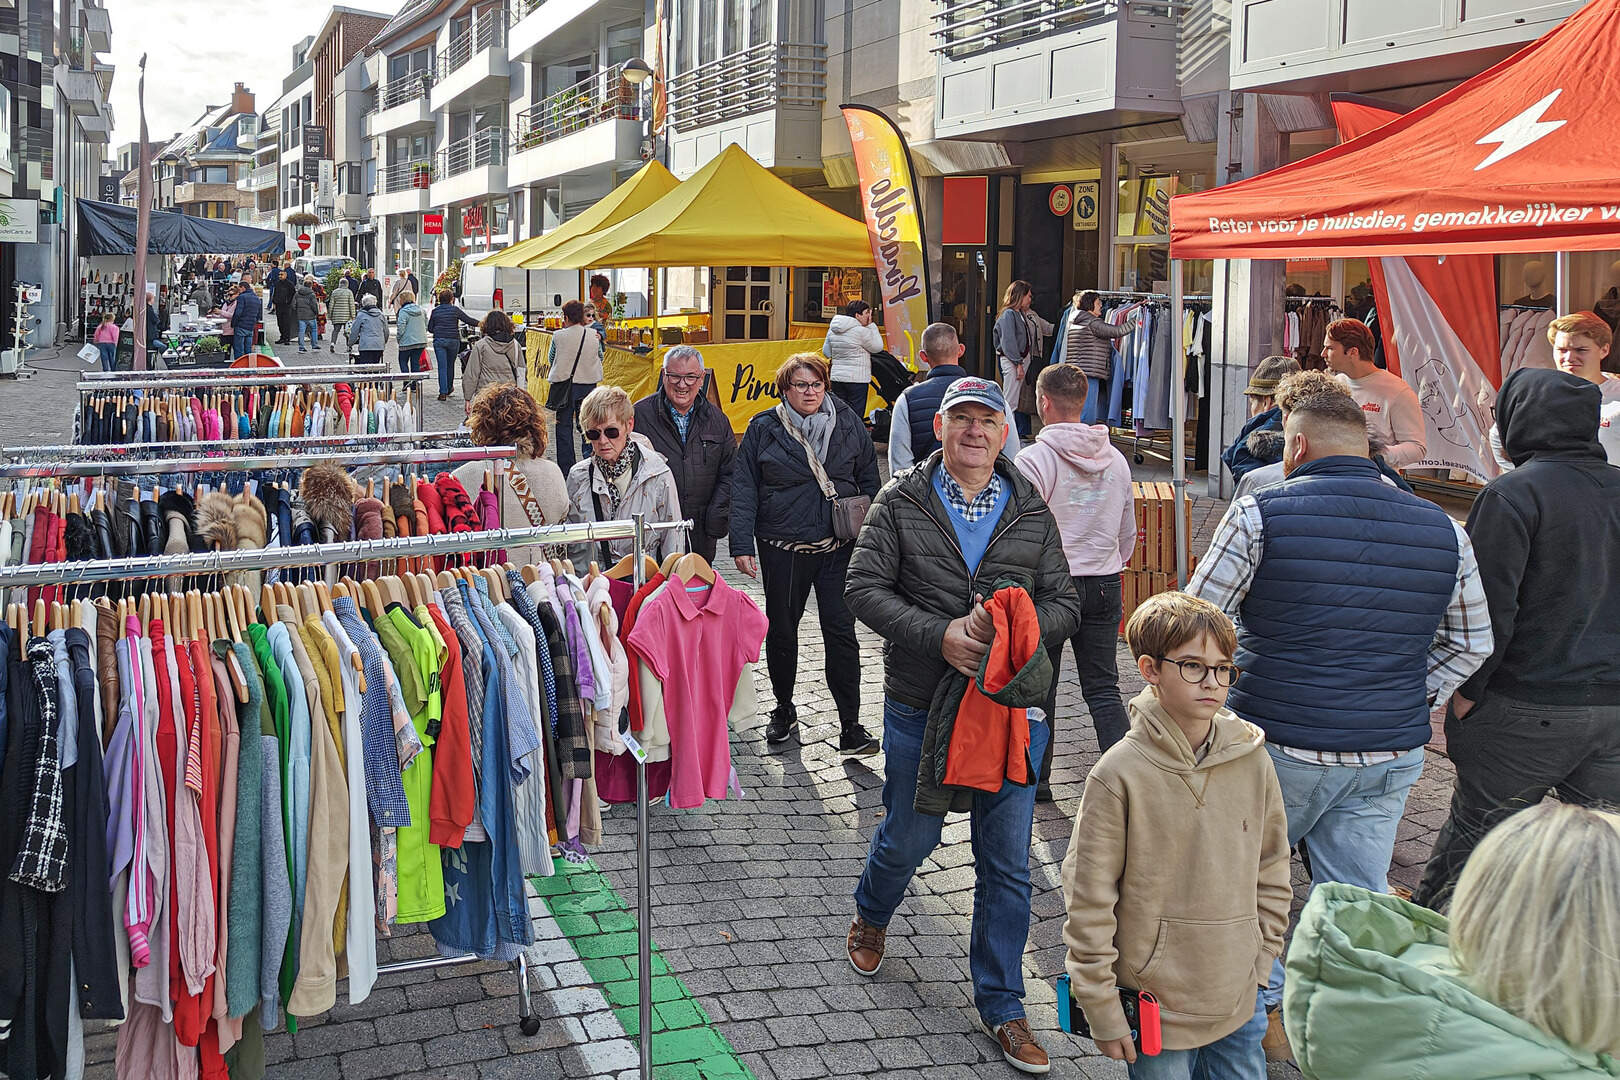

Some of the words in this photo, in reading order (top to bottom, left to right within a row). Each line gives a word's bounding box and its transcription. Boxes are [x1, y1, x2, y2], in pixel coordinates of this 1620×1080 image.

[307, 145, 320, 153] Lee
[1078, 185, 1095, 194] ZONE
[1208, 217, 1253, 233] Beter
[1257, 219, 1298, 233] voor
[1297, 215, 1319, 236] je
[1322, 210, 1406, 231] huisdier,
[1411, 203, 1593, 232] gemakkelijker
